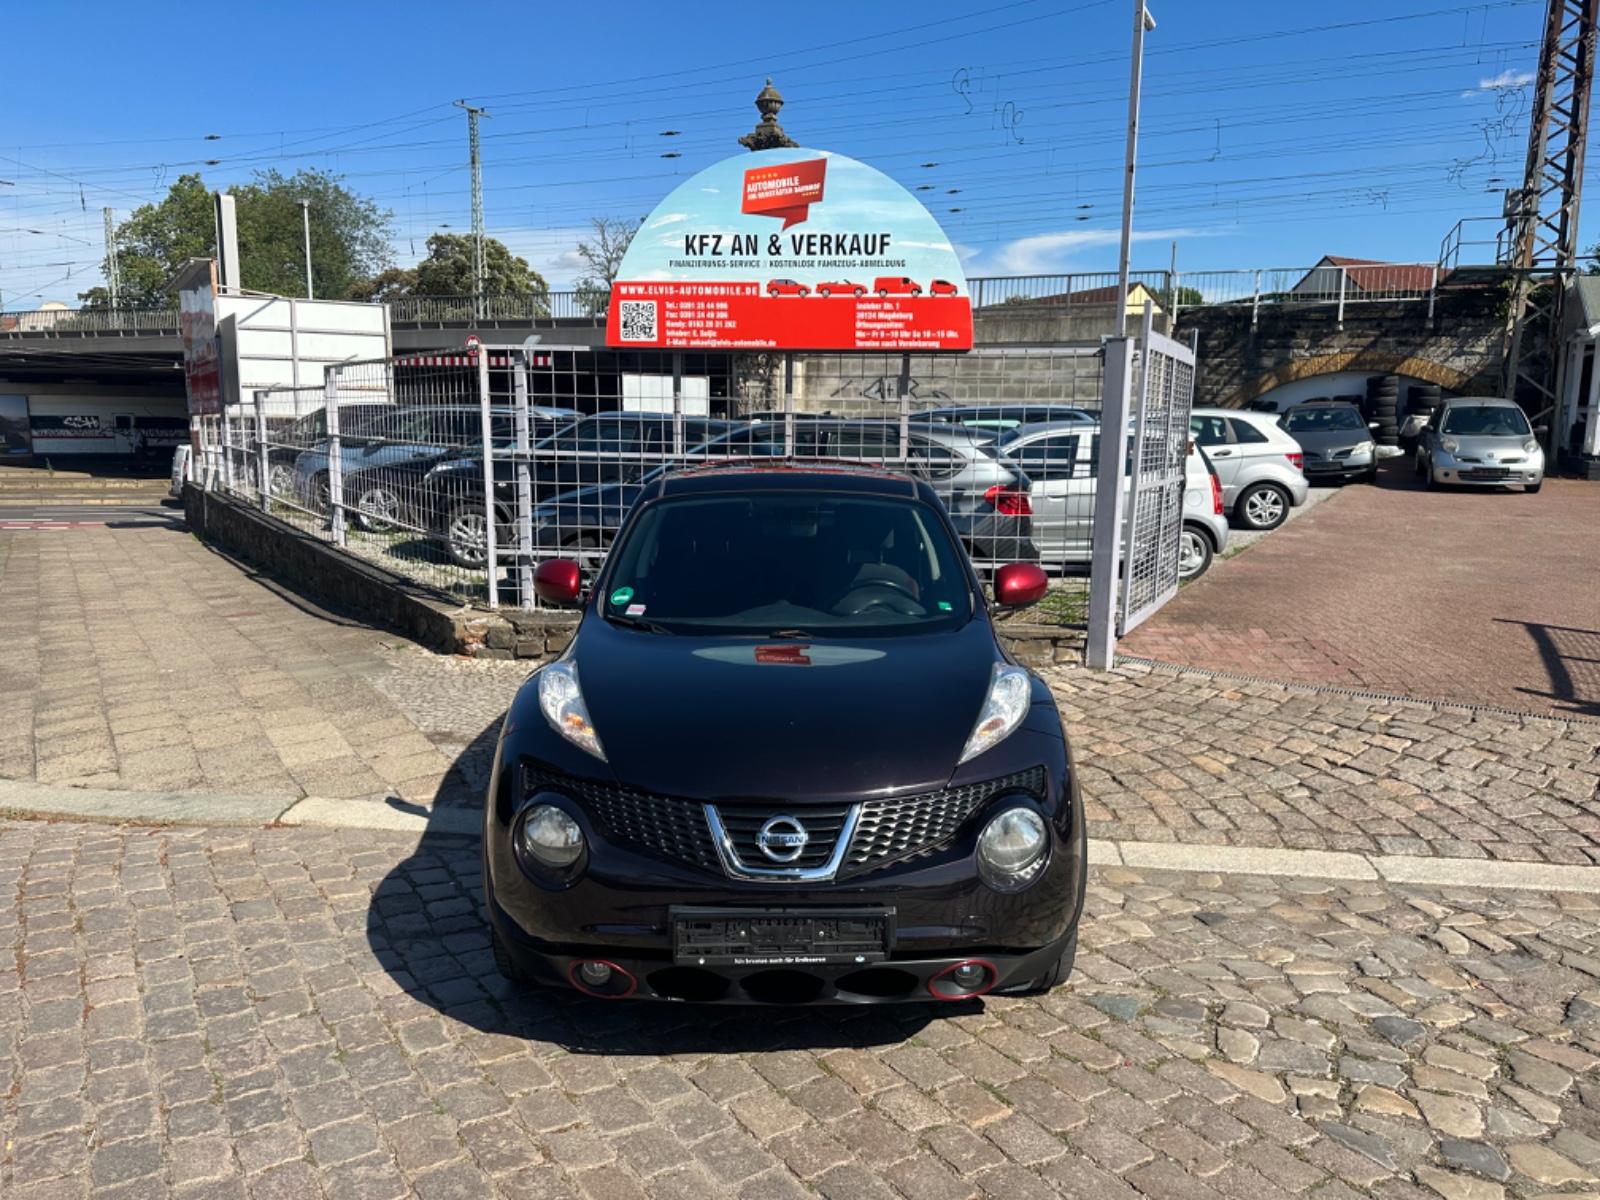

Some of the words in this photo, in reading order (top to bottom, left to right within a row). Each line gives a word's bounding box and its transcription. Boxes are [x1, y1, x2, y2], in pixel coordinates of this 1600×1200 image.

[747, 176, 800, 193] AUTOMOBILE
[685, 234, 722, 256] KFZ
[731, 234, 758, 256] AN
[767, 234, 782, 256] &
[791, 234, 891, 256] VERKAUF
[669, 260, 760, 268] FINANZIERUNGS-SERVICE
[769, 260, 815, 268] KOSTENLOSE
[817, 260, 906, 268] FAHRZEUG-ABMELDUNG
[619, 286, 758, 296] WWW.ELVIS-AUTOMOBILE.DE
[877, 312, 913, 321] Magdeburg
[665, 320, 687, 328] Handy:
[761, 835, 804, 844] NISSAN
